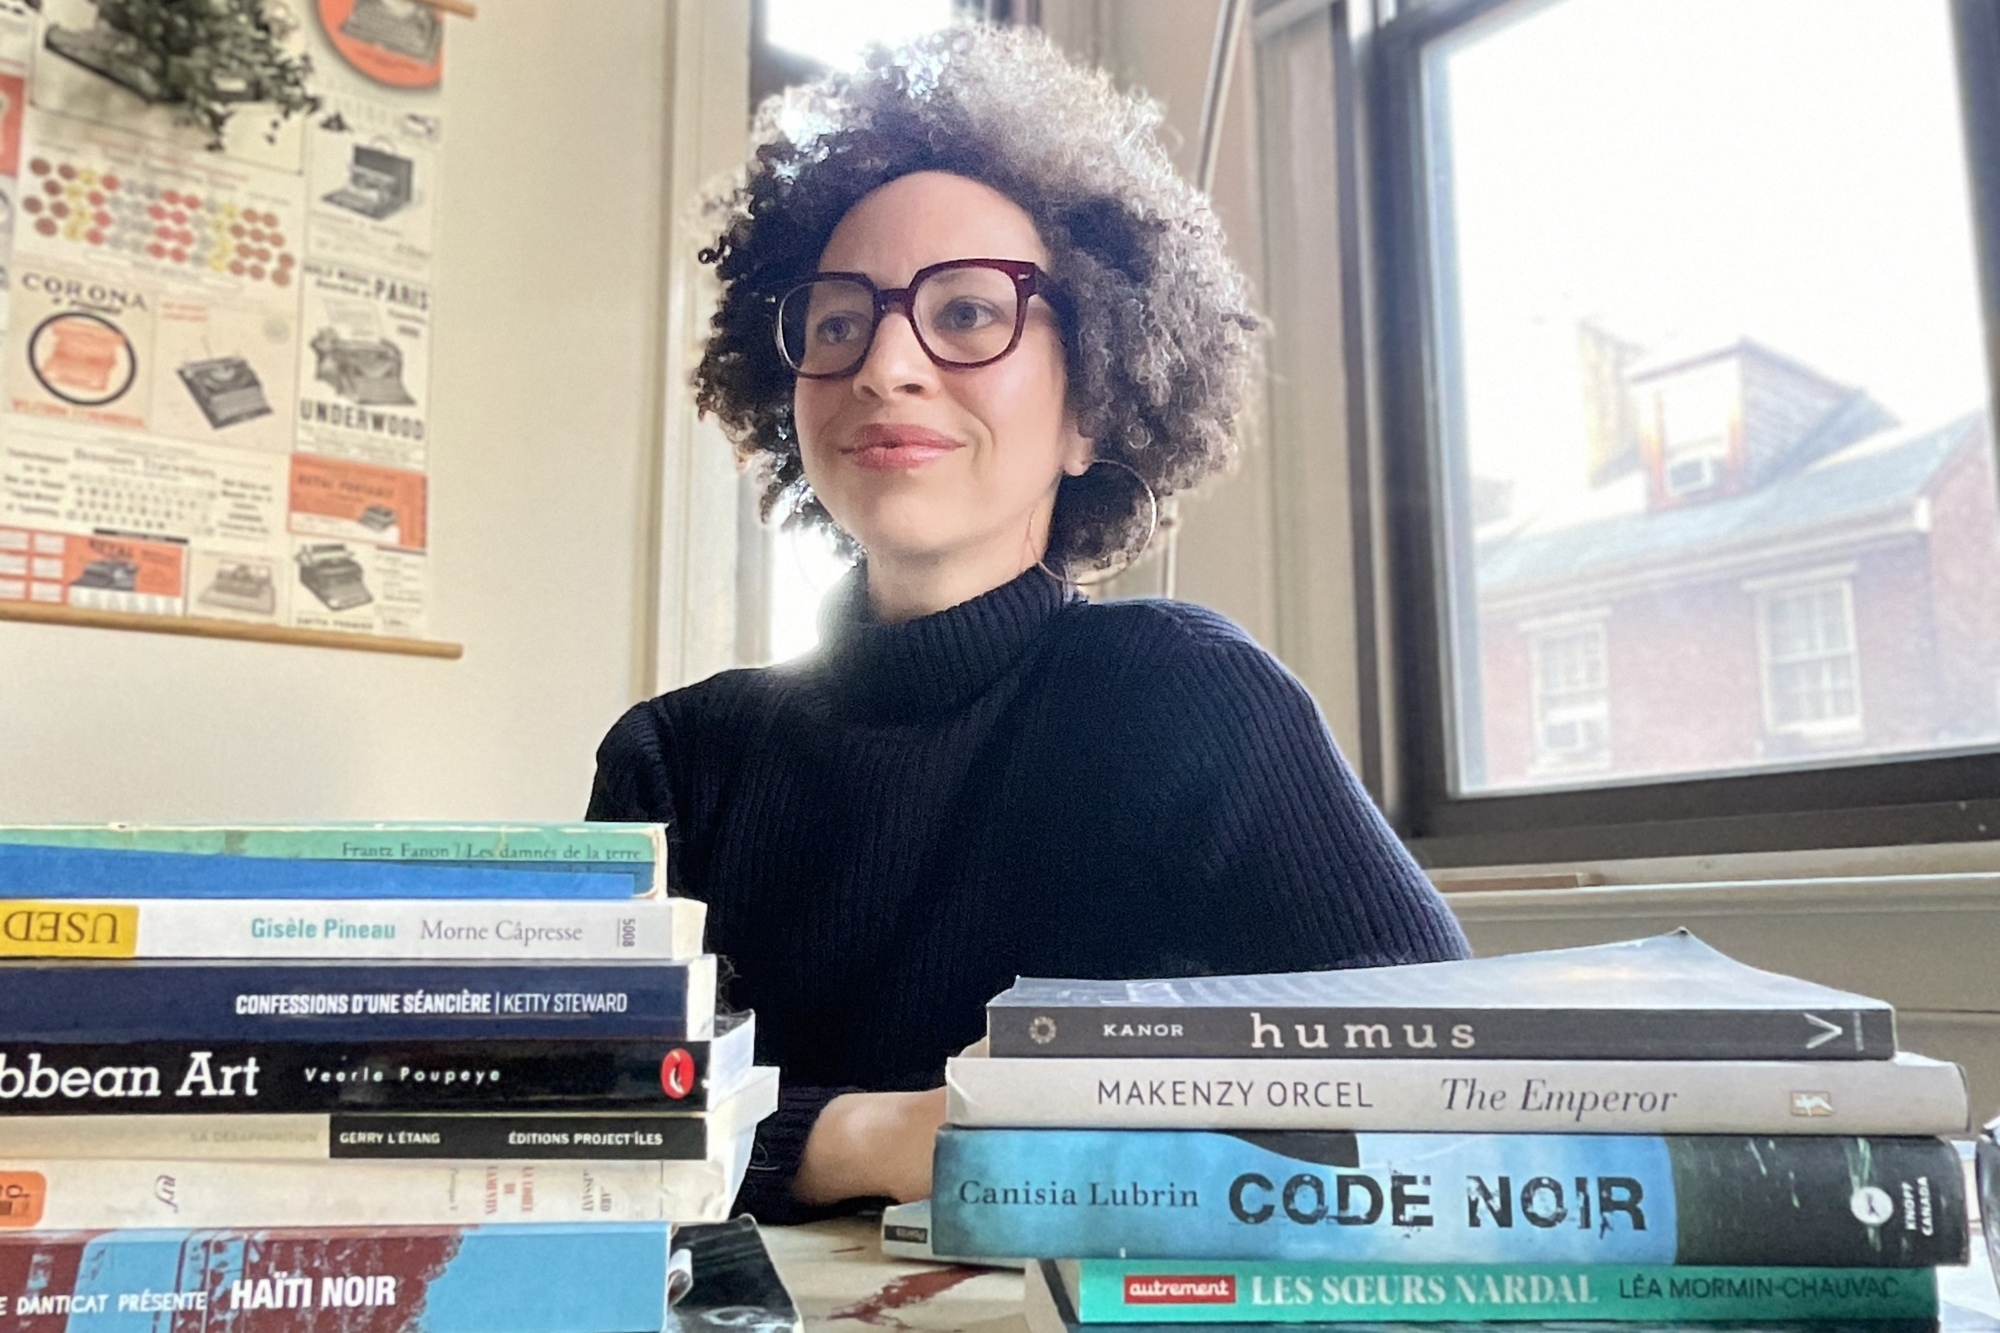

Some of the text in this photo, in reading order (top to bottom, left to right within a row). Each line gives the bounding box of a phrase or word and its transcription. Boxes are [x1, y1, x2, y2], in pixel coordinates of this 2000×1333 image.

[21, 271, 147, 312] CORONA
[300, 398, 424, 441] UNDERWOOD
[342, 842, 642, 860] Frantz Fanon Les damnés de la terre
[3, 910, 120, 943] USED
[251, 917, 396, 939] Gisèle Pineau
[420, 918, 583, 946] Morne Câpresse
[622, 918, 636, 947] 5008
[236, 989, 491, 1015] CONFESSIONS D'UNE SÉANCIÈRE
[503, 993, 628, 1013] KETTY STEWARD
[1103, 1023, 1184, 1037] KANOR
[1251, 1012, 1476, 1049] humus
[176, 1052, 260, 1097] Art
[305, 1067, 500, 1085] Veerle Poupeye
[1098, 1080, 1373, 1108] MAKENZY ORCEL
[1441, 1077, 1679, 1122] The Emperor
[340, 1132, 384, 1144] GERRY
[508, 1131, 569, 1145] ÉDITIONS
[959, 1180, 1199, 1208] Canisia Lubrin
[1228, 1172, 1647, 1232] CODE NOIR
[1902, 1181, 1918, 1231] KNOPF
[1917, 1176, 1934, 1237] CANADA
[230, 1271, 397, 1310] HAÏTI NOIR
[1129, 1279, 1229, 1296] autrement
[1252, 1273, 1599, 1305] LES SŒURS NARDAL
[1619, 1273, 1900, 1299] LÉA MORMIN-CHAUVAC
[17, 1294, 109, 1315] DANTICAT
[118, 1288, 208, 1311] PRÉSENTE
